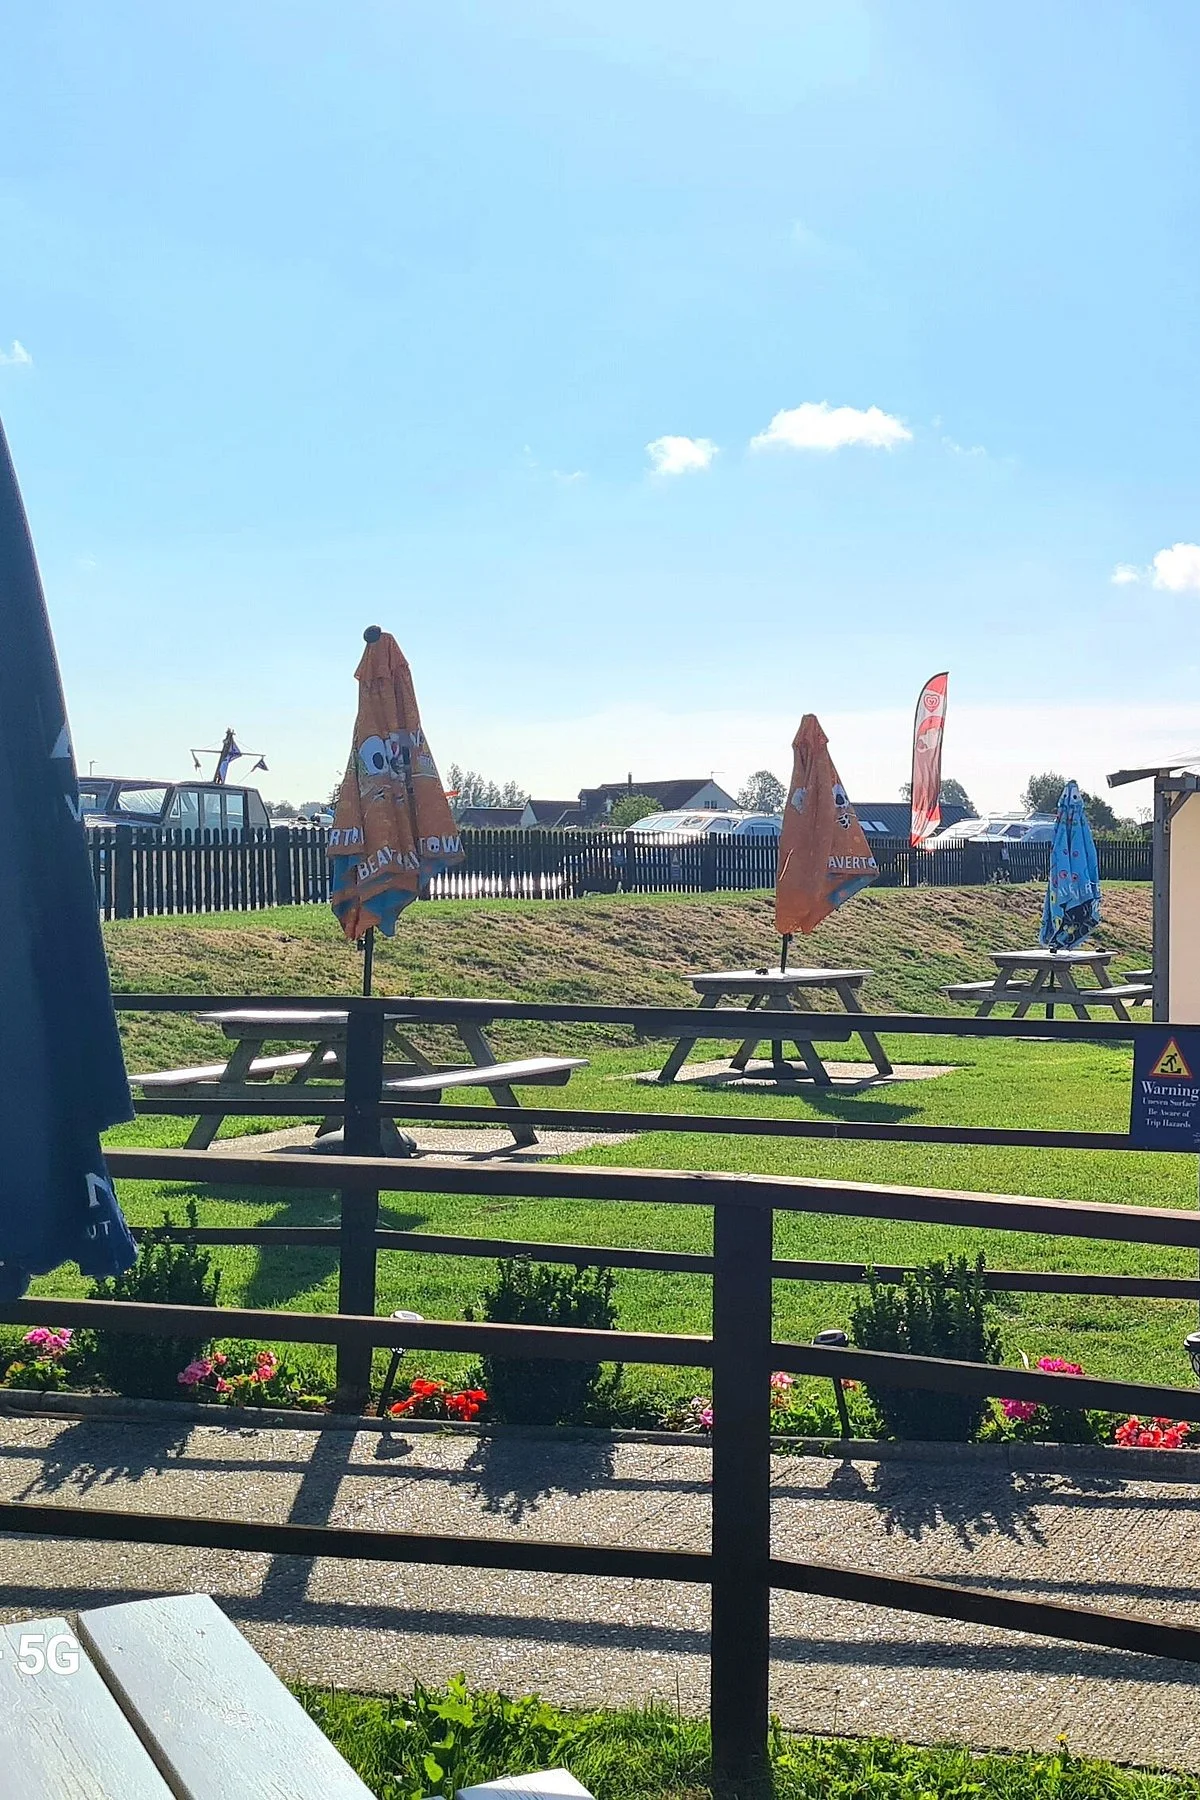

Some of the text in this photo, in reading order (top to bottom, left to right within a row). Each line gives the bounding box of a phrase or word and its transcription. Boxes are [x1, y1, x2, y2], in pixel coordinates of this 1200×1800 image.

[1141, 1080, 1200, 1102] Warning
[1142, 1097, 1197, 1107] Uneven Surface
[1148, 1108, 1191, 1118] Be Aware of
[1145, 1118, 1191, 1129] Trip Hazards
